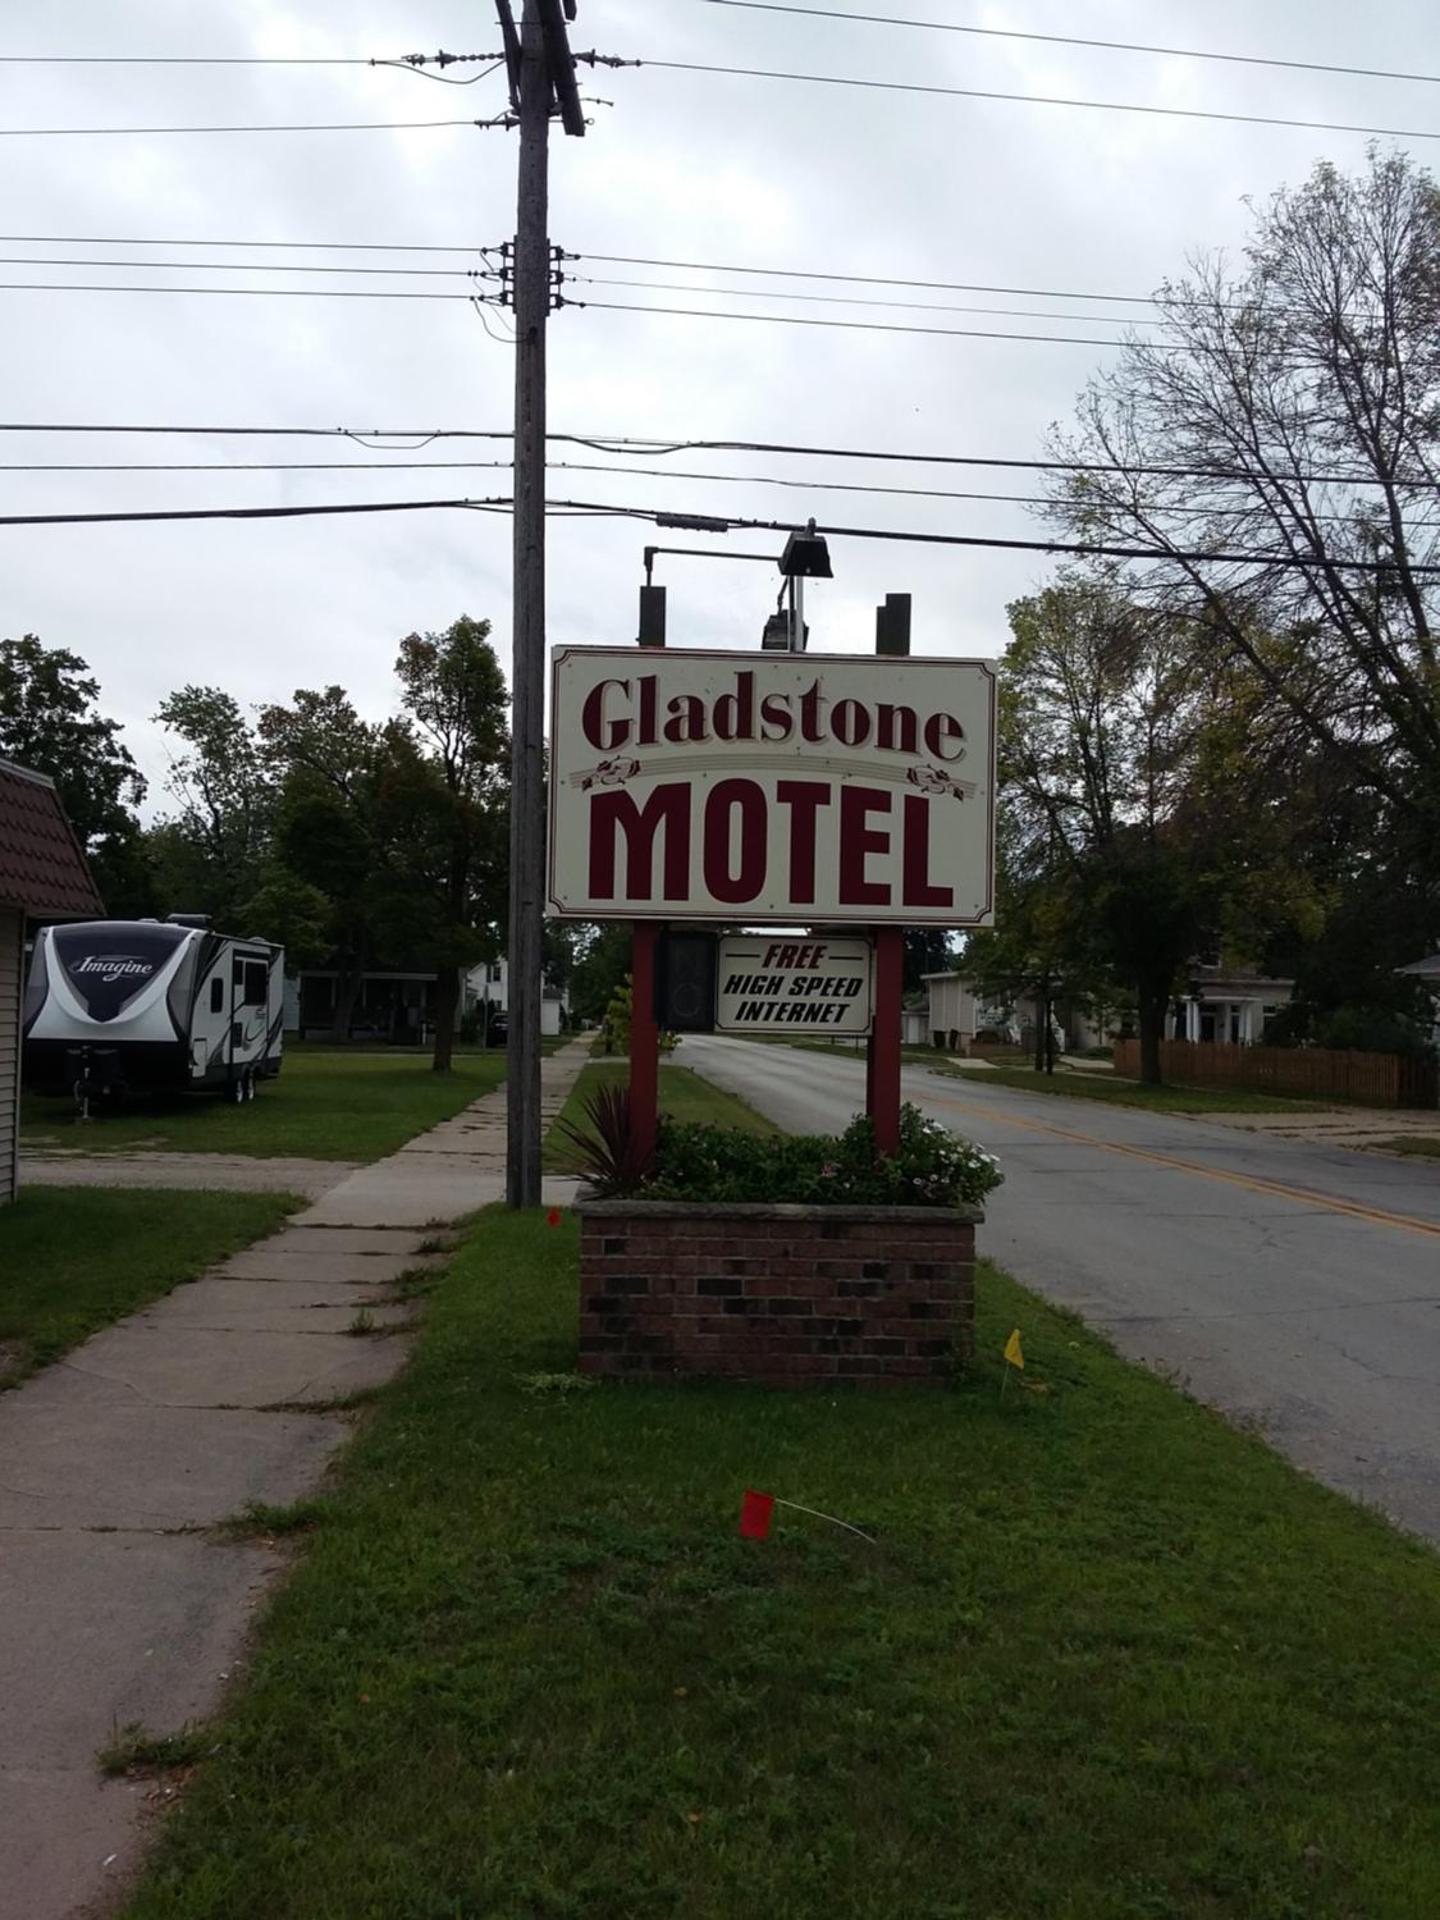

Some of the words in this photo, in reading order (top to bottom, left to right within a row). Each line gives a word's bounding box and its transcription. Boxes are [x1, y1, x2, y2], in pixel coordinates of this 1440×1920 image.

[582, 670, 966, 761] Gladstone
[588, 778, 954, 907] MOTEL
[77, 956, 153, 982] Imagine
[762, 944, 828, 969] FREE
[723, 974, 785, 996] HIGH
[788, 976, 864, 998] SPEED
[734, 1001, 850, 1024] INTERNET
